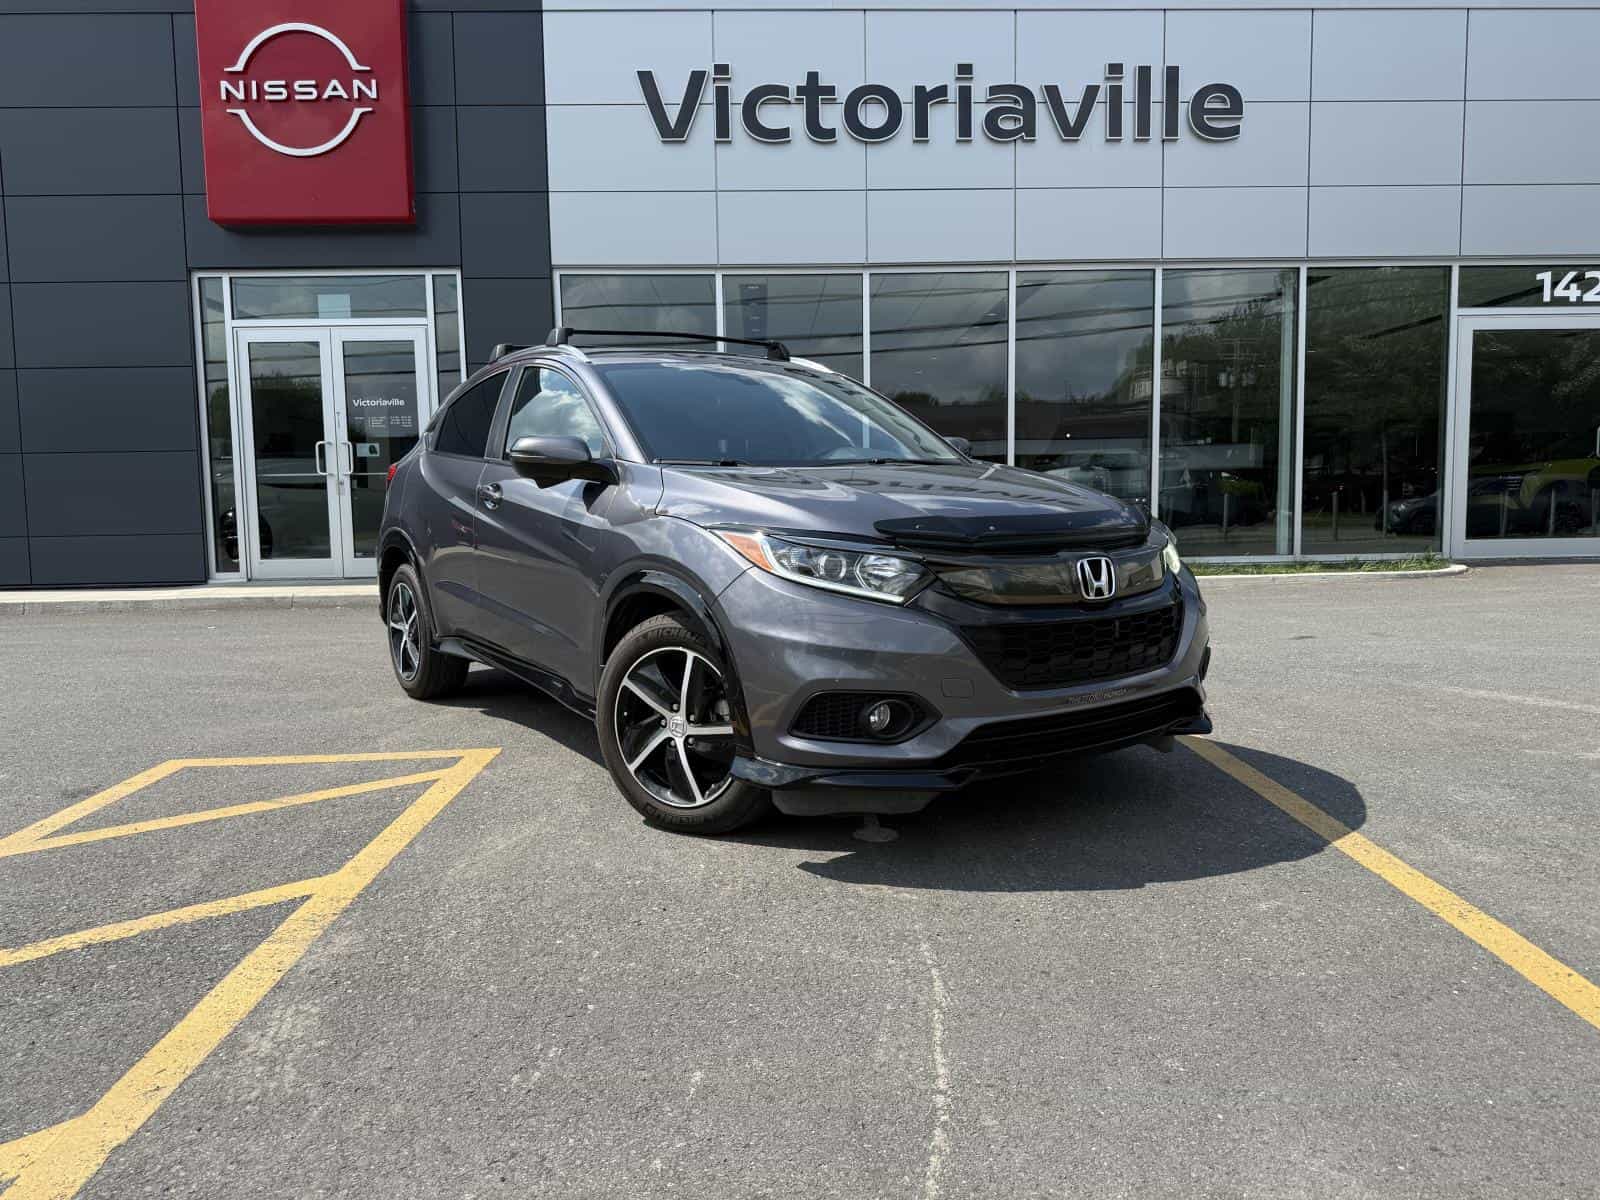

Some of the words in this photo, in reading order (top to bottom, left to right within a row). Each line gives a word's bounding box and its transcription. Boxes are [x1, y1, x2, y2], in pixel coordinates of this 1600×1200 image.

[220, 79, 378, 101] NISSAN
[635, 63, 1244, 142] Victoriaville
[1535, 270, 1600, 303] 142
[353, 398, 405, 407] Victoriaville
